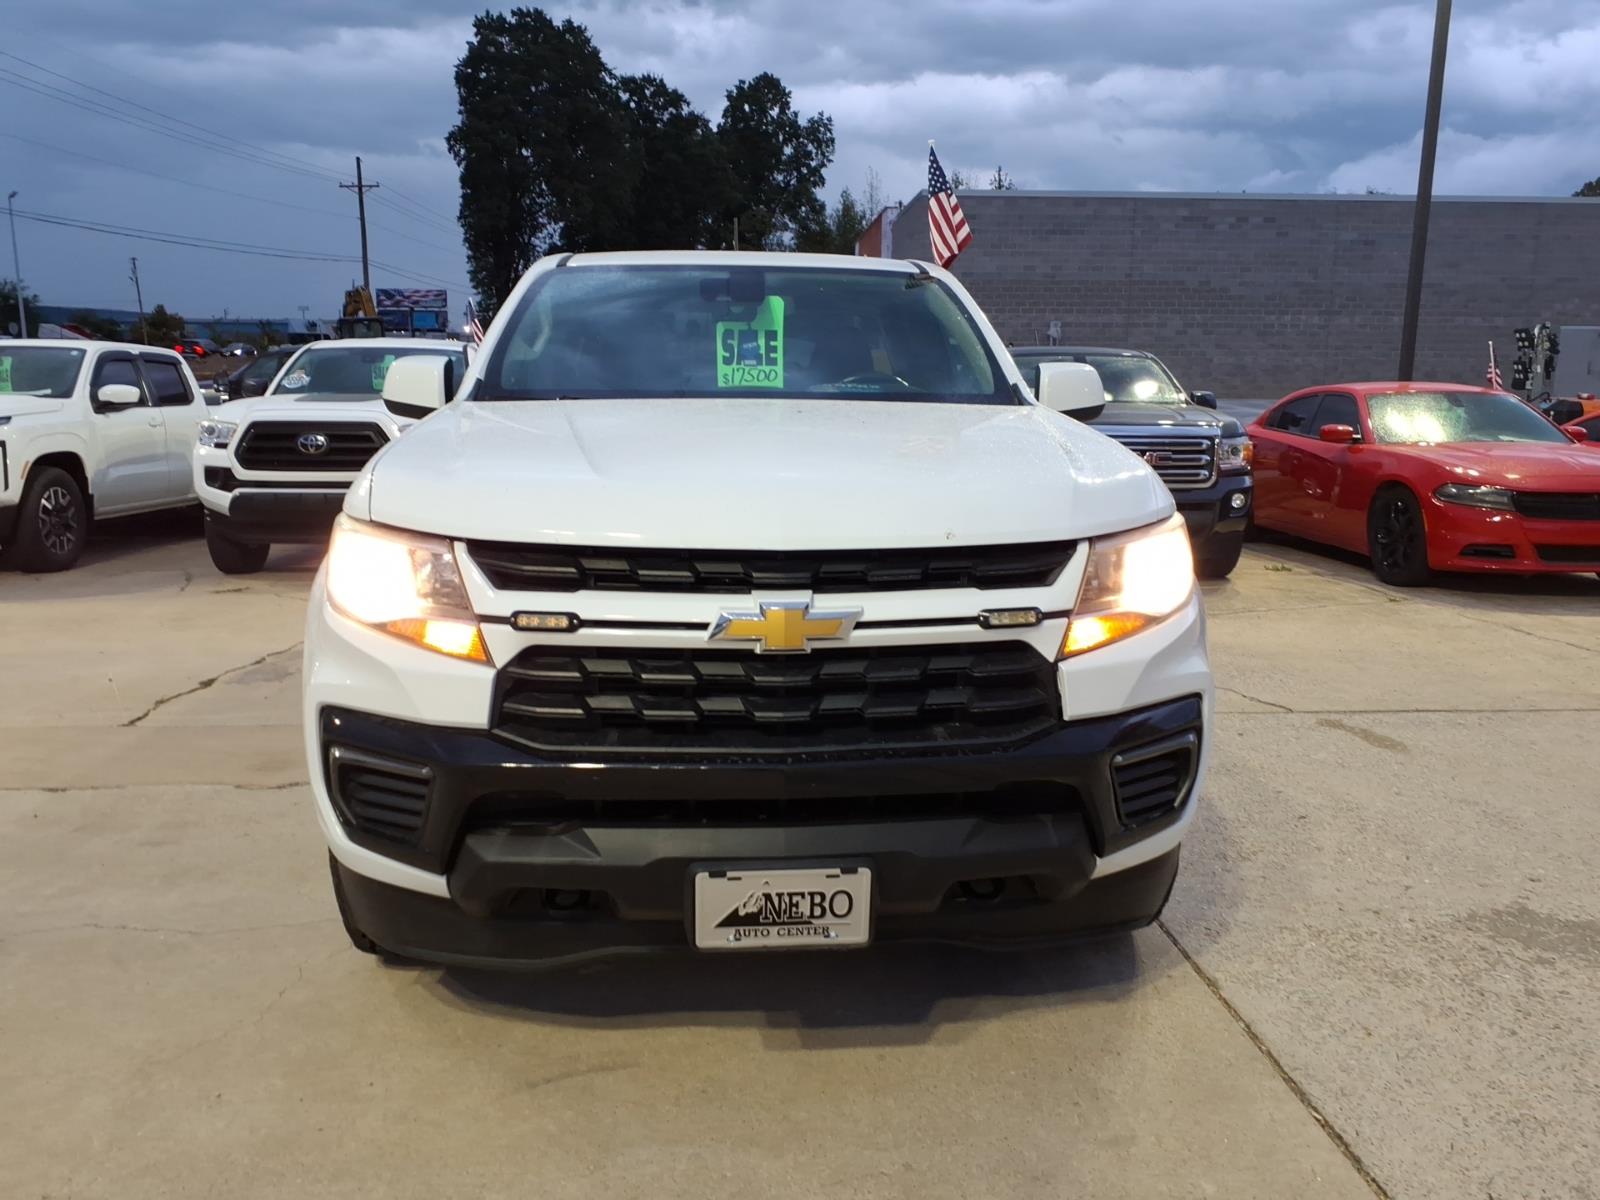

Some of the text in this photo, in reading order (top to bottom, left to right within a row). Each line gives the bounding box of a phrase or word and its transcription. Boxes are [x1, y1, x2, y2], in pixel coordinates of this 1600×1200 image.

[722, 367, 778, 385] $17500
[1136, 451, 1172, 466] MC
[761, 889, 854, 922] NEBO
[734, 926, 830, 939] AUTO CENTER
